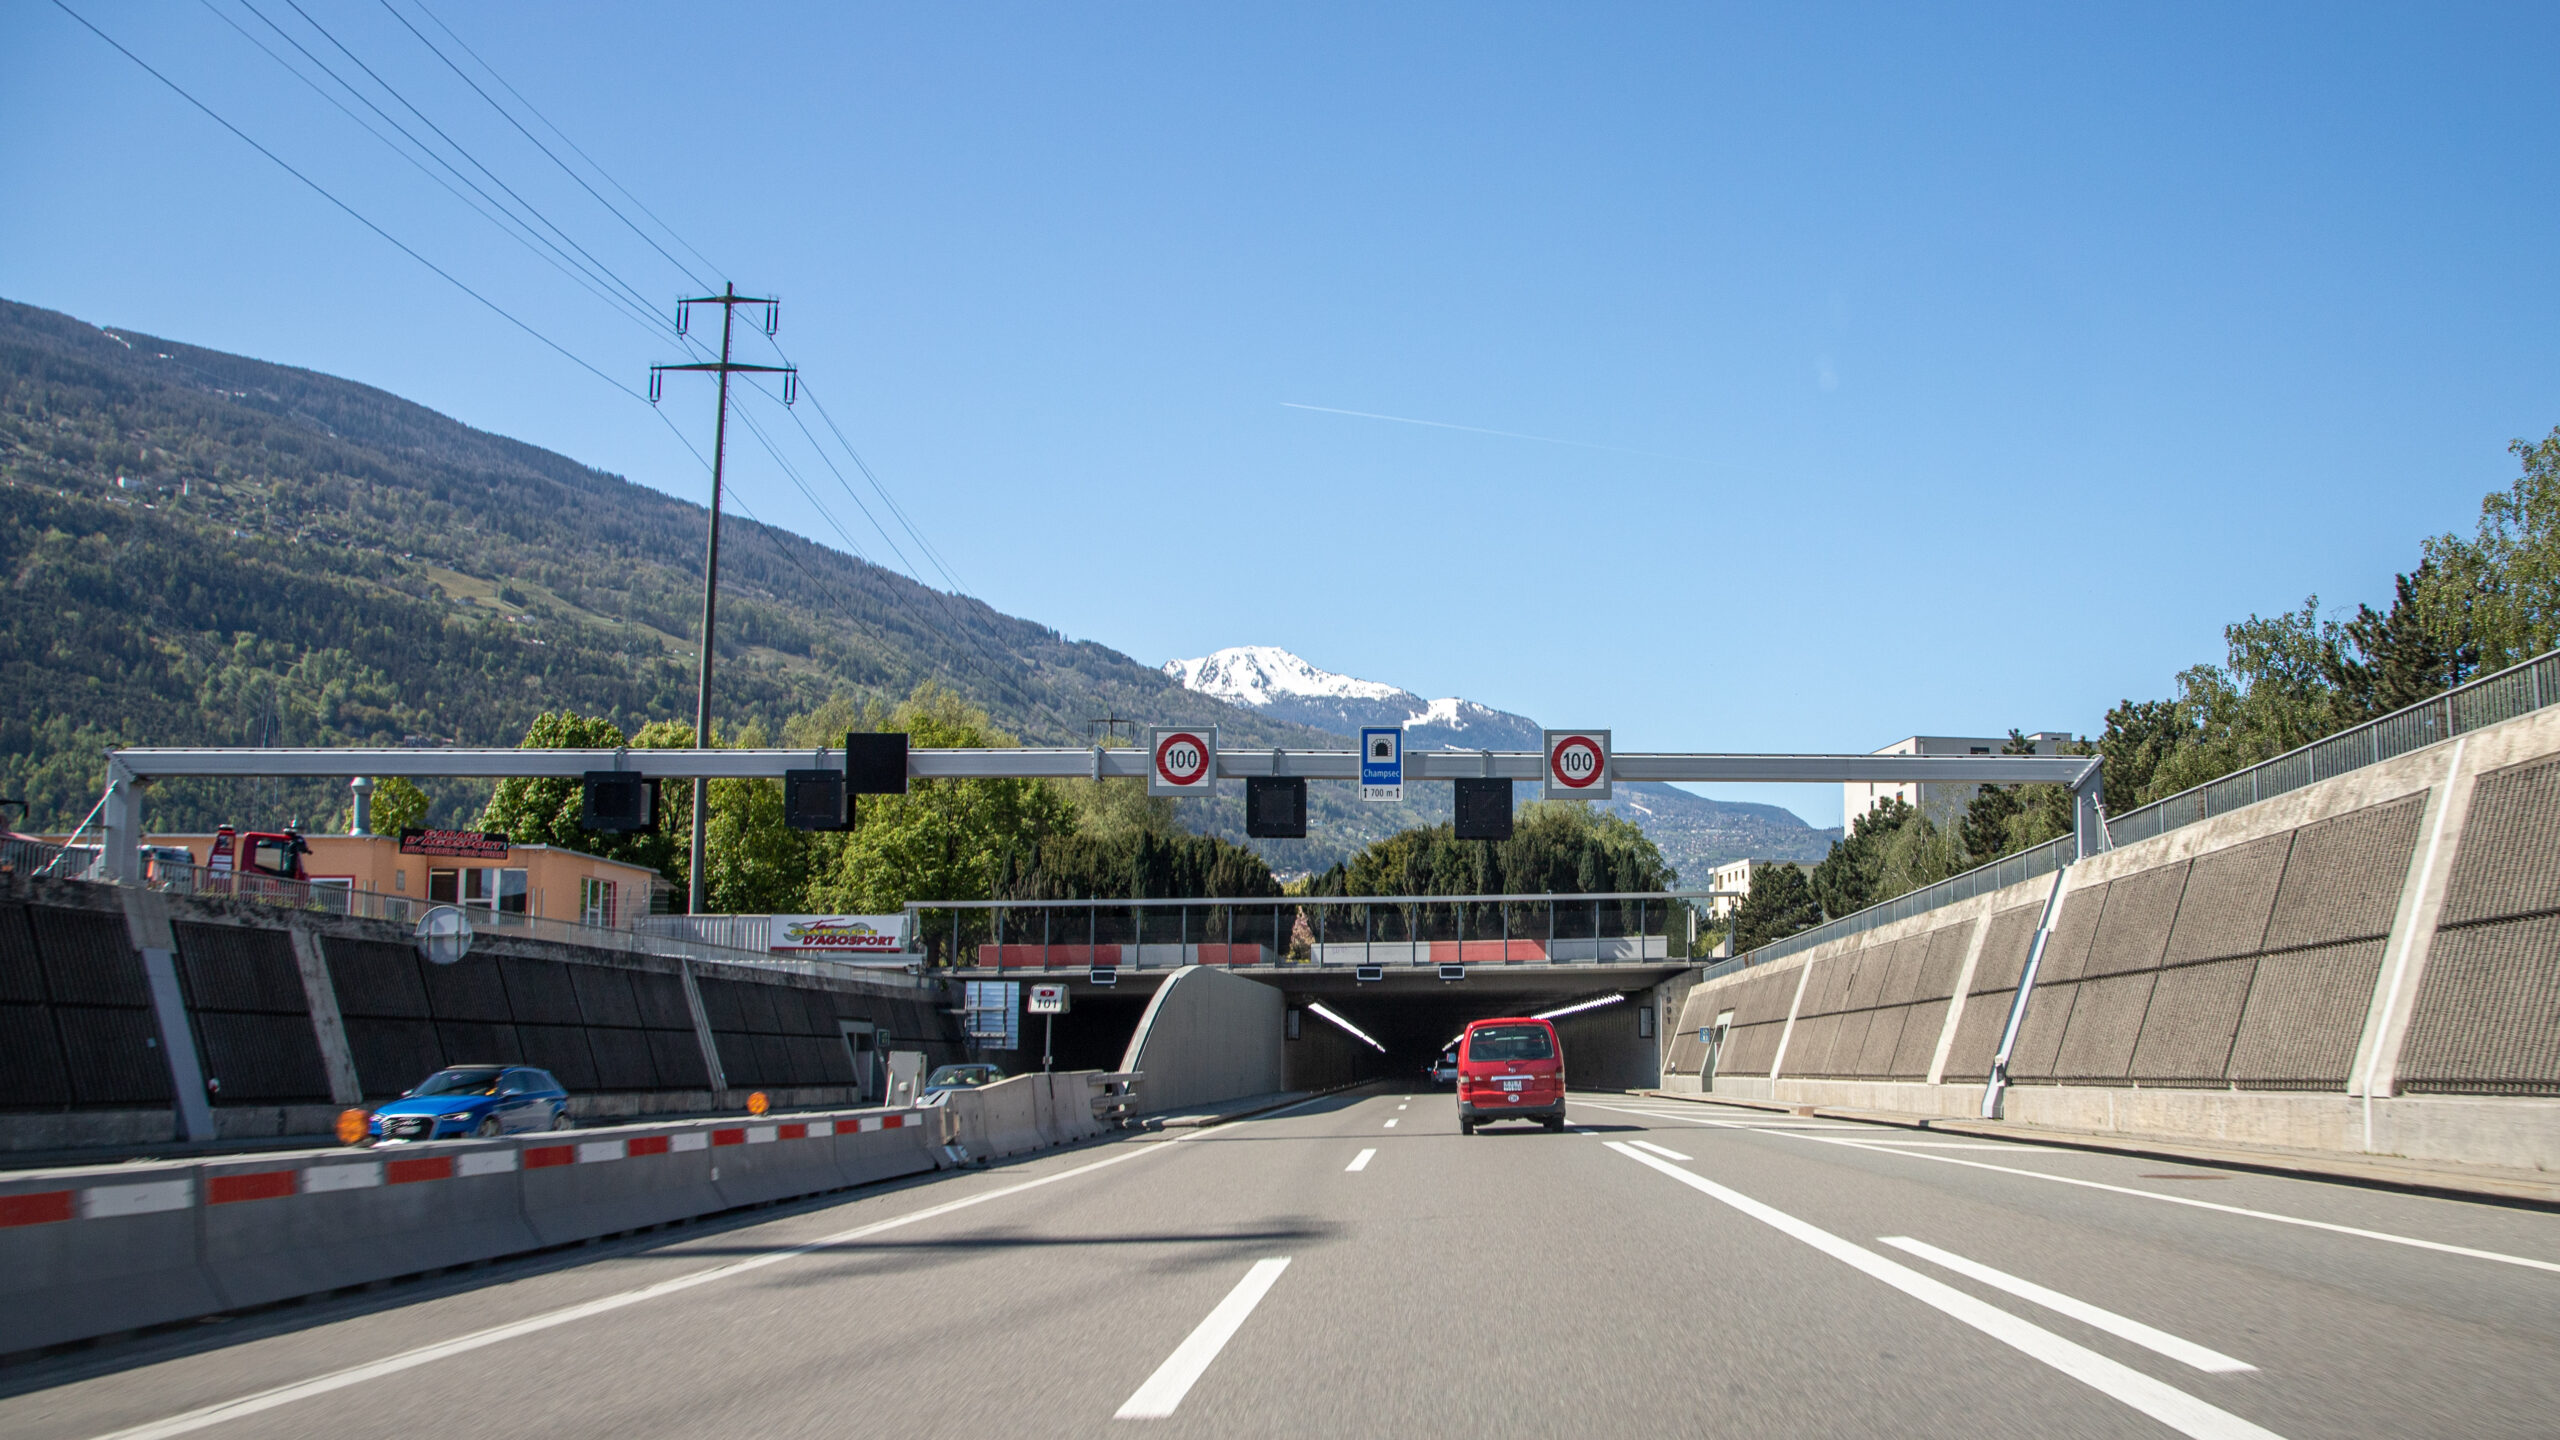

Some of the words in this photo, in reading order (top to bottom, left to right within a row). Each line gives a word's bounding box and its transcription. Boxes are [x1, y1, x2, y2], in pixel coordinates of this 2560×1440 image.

[1168, 750, 1197, 769] 100
[1563, 753, 1593, 772] 100
[1363, 768, 1400, 779] Champsec
[1370, 788, 1384, 797] 700
[424, 829, 484, 841] GARAGE
[802, 935, 896, 946] D'AGOSPORT
[1036, 999, 1057, 1009] 101
